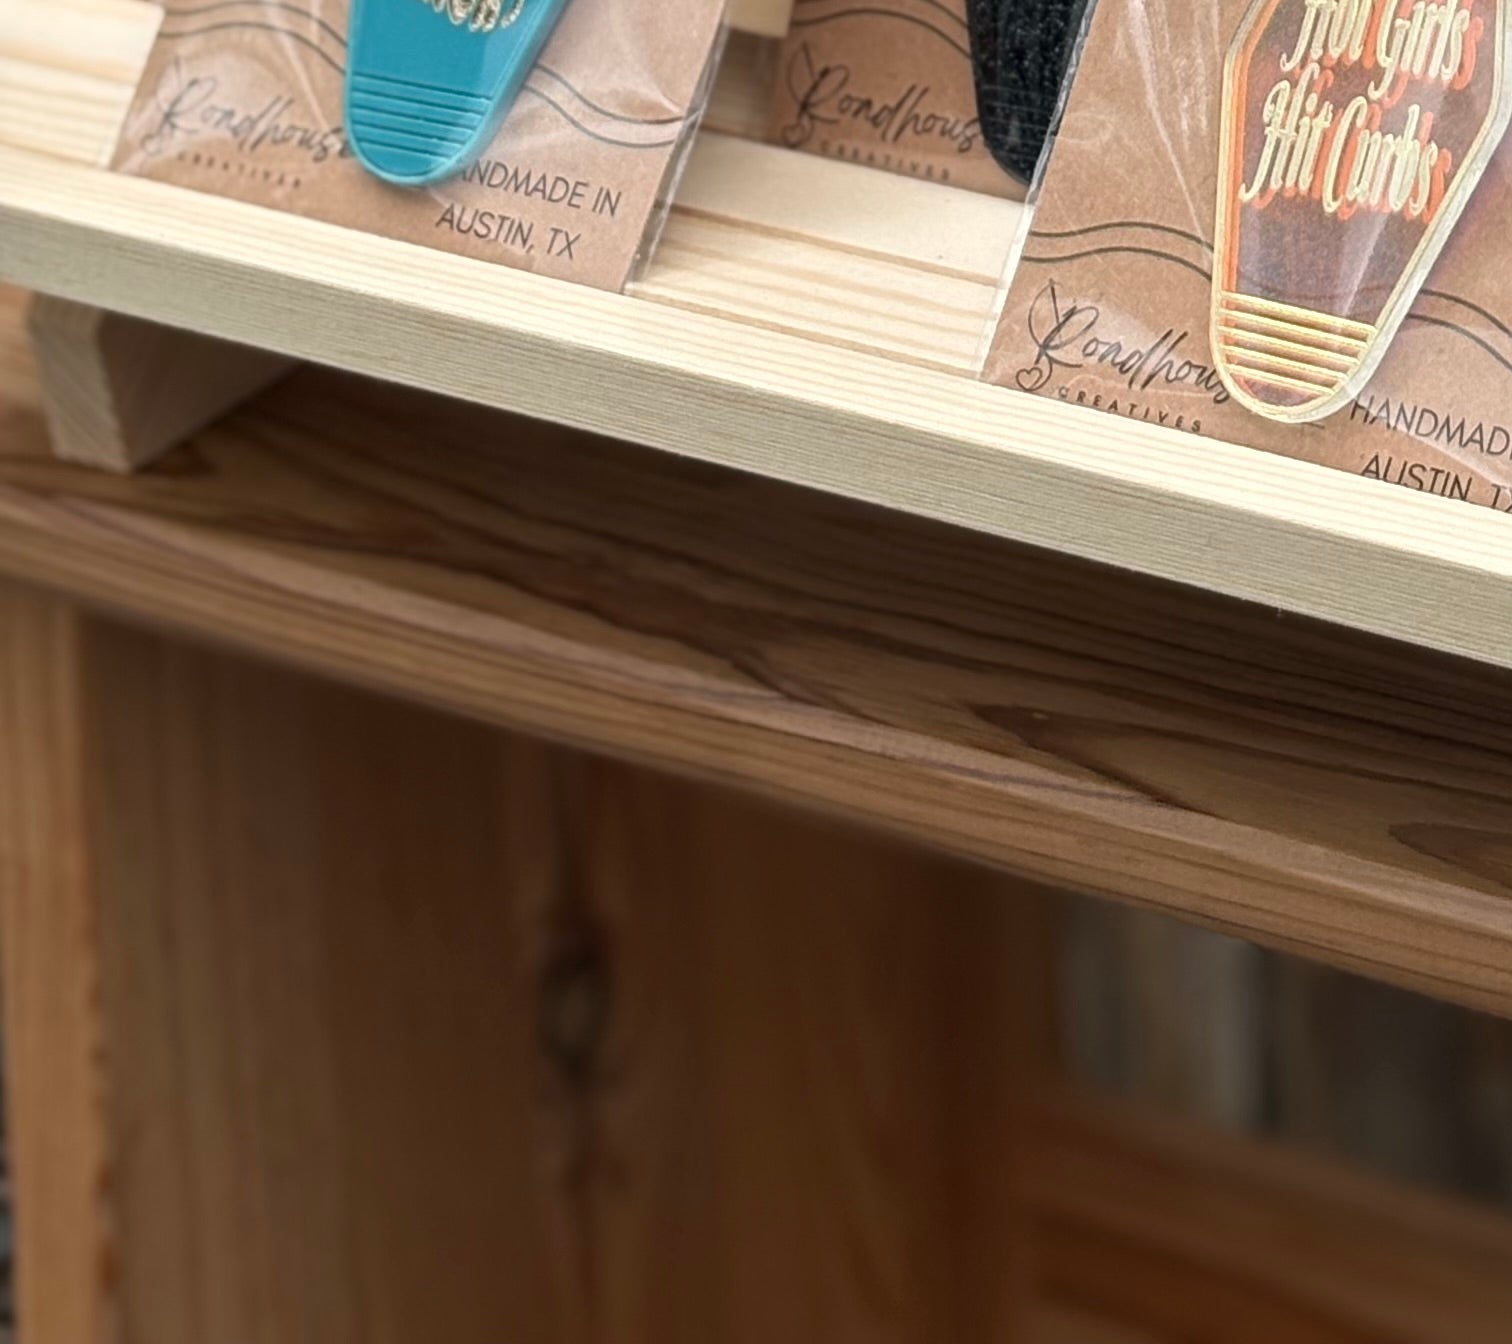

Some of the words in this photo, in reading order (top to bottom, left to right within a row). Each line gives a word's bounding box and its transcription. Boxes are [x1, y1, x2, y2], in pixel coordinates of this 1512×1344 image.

[797, 64, 982, 154] Roadhous
[1238, 62, 1335, 204] Hit
[1322, 96, 1440, 216] Curbs
[466, 160, 589, 210] NDMADE
[592, 186, 622, 217] IN
[435, 203, 535, 254] AUSTIN,
[547, 227, 582, 260] TX
[1034, 305, 1231, 405] Roadhous
[1057, 385, 1202, 433] CREATIVES
